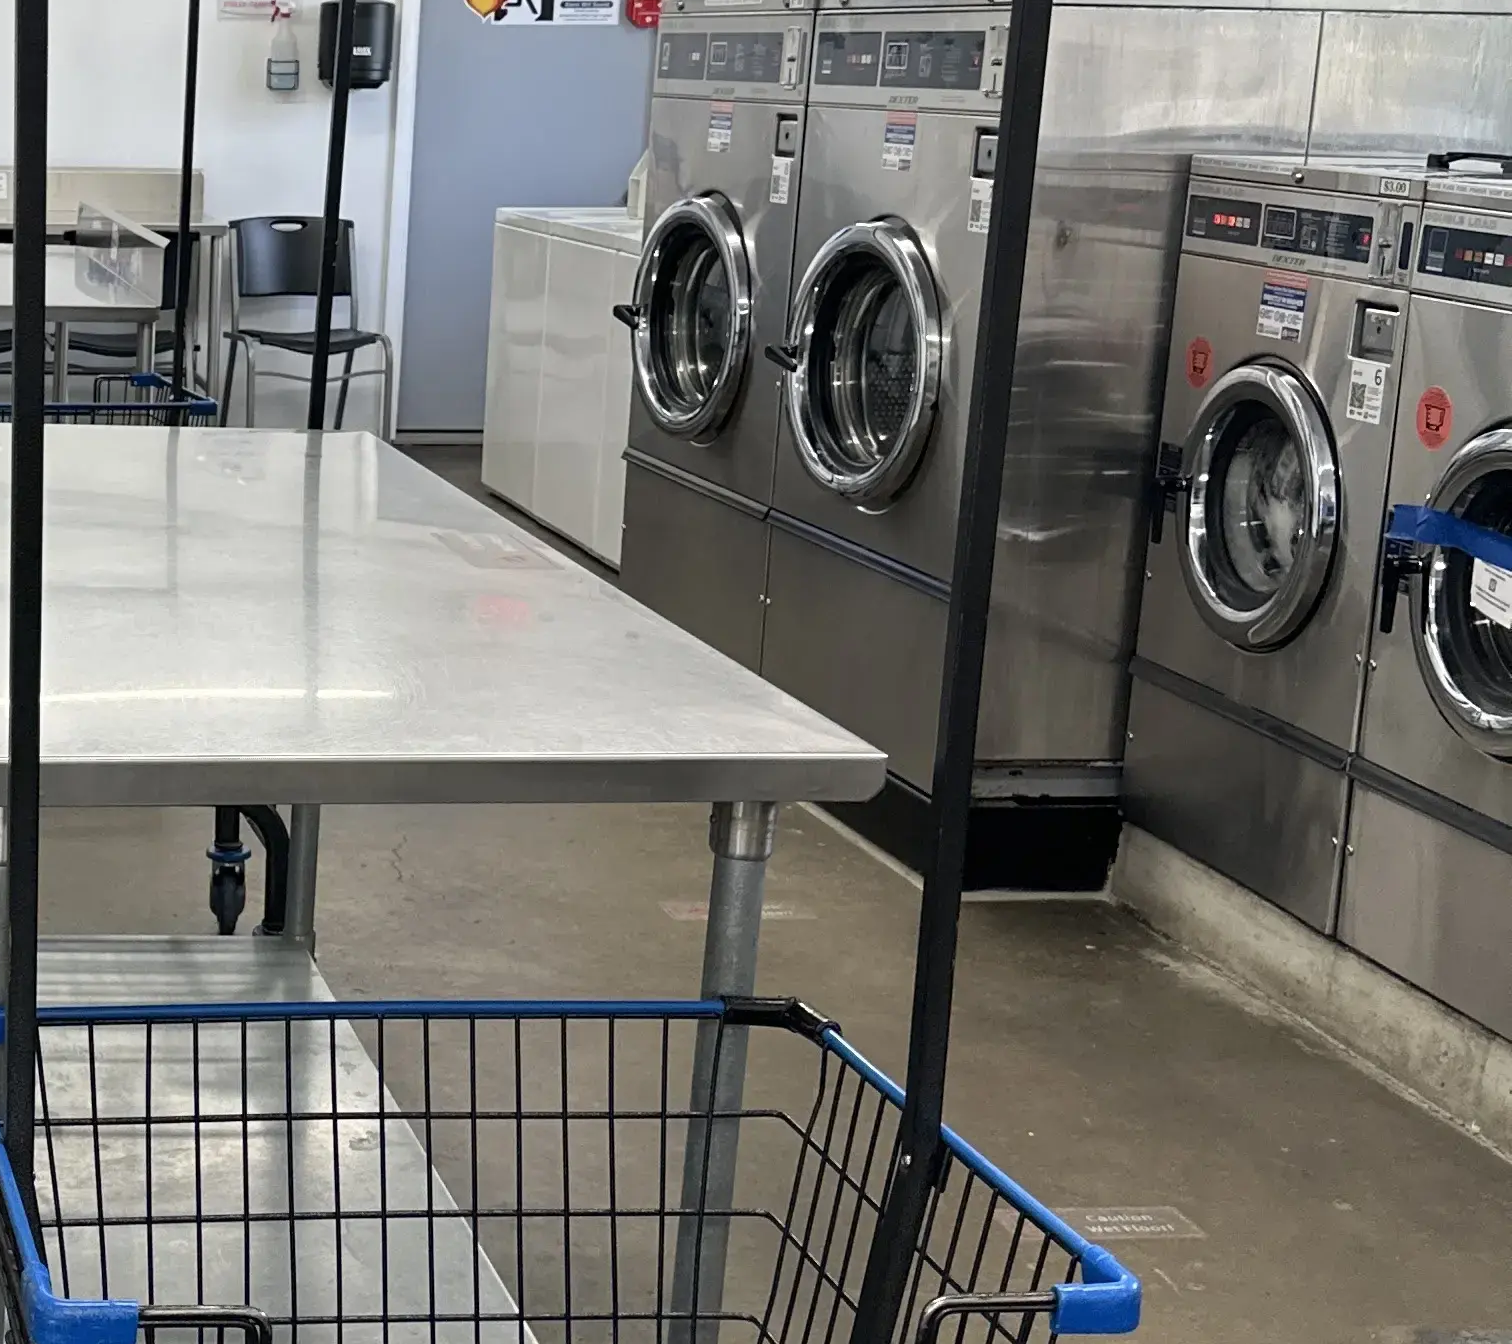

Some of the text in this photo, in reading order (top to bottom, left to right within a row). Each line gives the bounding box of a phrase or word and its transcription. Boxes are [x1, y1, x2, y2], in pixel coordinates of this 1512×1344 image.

[1383, 181, 1407, 193] $3.00
[1374, 369, 1383, 386] 6
[1085, 1213, 1153, 1222] Caution
[1084, 1224, 1121, 1233] Wet
